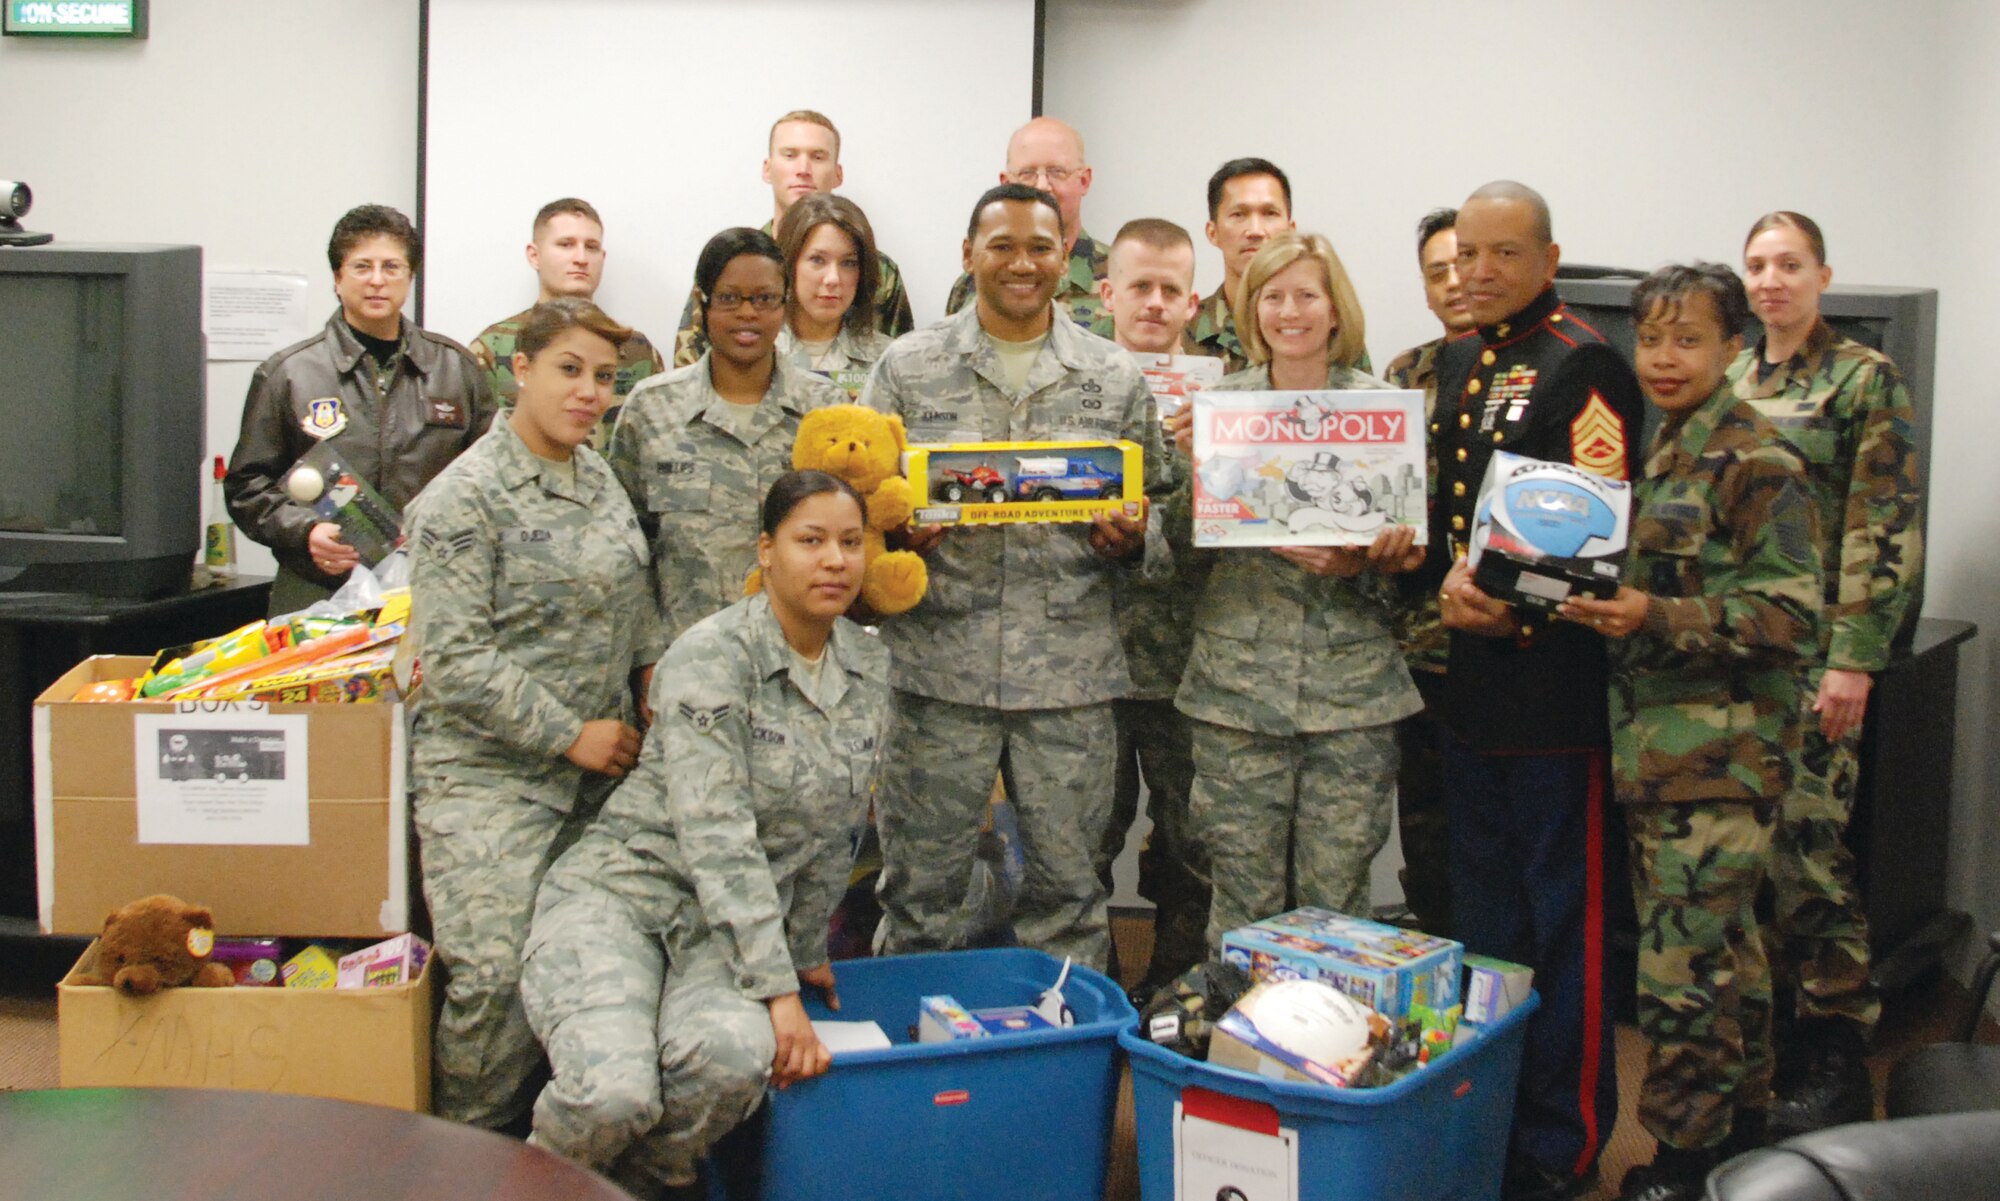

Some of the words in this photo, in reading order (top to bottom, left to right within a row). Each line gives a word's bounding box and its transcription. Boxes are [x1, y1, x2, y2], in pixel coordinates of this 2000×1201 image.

[18, 2, 129, 24] ON-SECURE
[1214, 415, 1402, 442] MONOPOLY
[1198, 503, 1240, 514] FASTER
[1516, 489, 1591, 517] NCAA
[970, 509, 1021, 520] OFF-ROAD
[1024, 508, 1085, 519] ADVENTURE
[281, 686, 307, 702] 24
